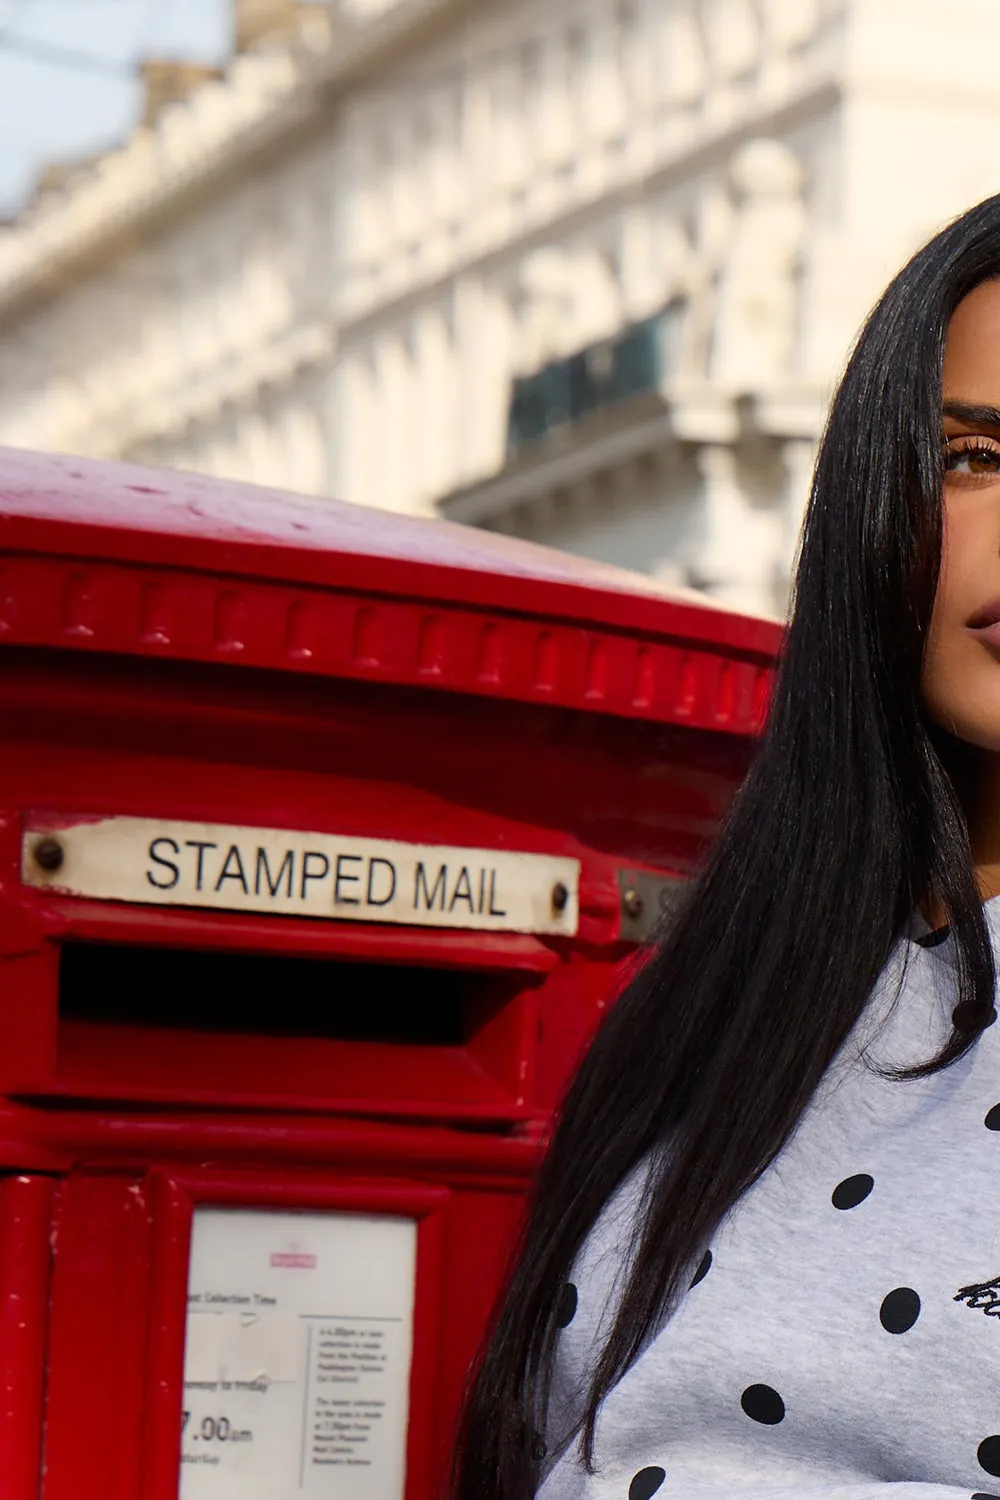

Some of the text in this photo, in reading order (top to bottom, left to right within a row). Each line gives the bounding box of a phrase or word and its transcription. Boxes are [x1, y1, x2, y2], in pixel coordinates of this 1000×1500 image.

[146, 837, 507, 917] STAMPED MAIL
[204, 1290, 250, 1305] Collection
[252, 1292, 277, 1306] Time
